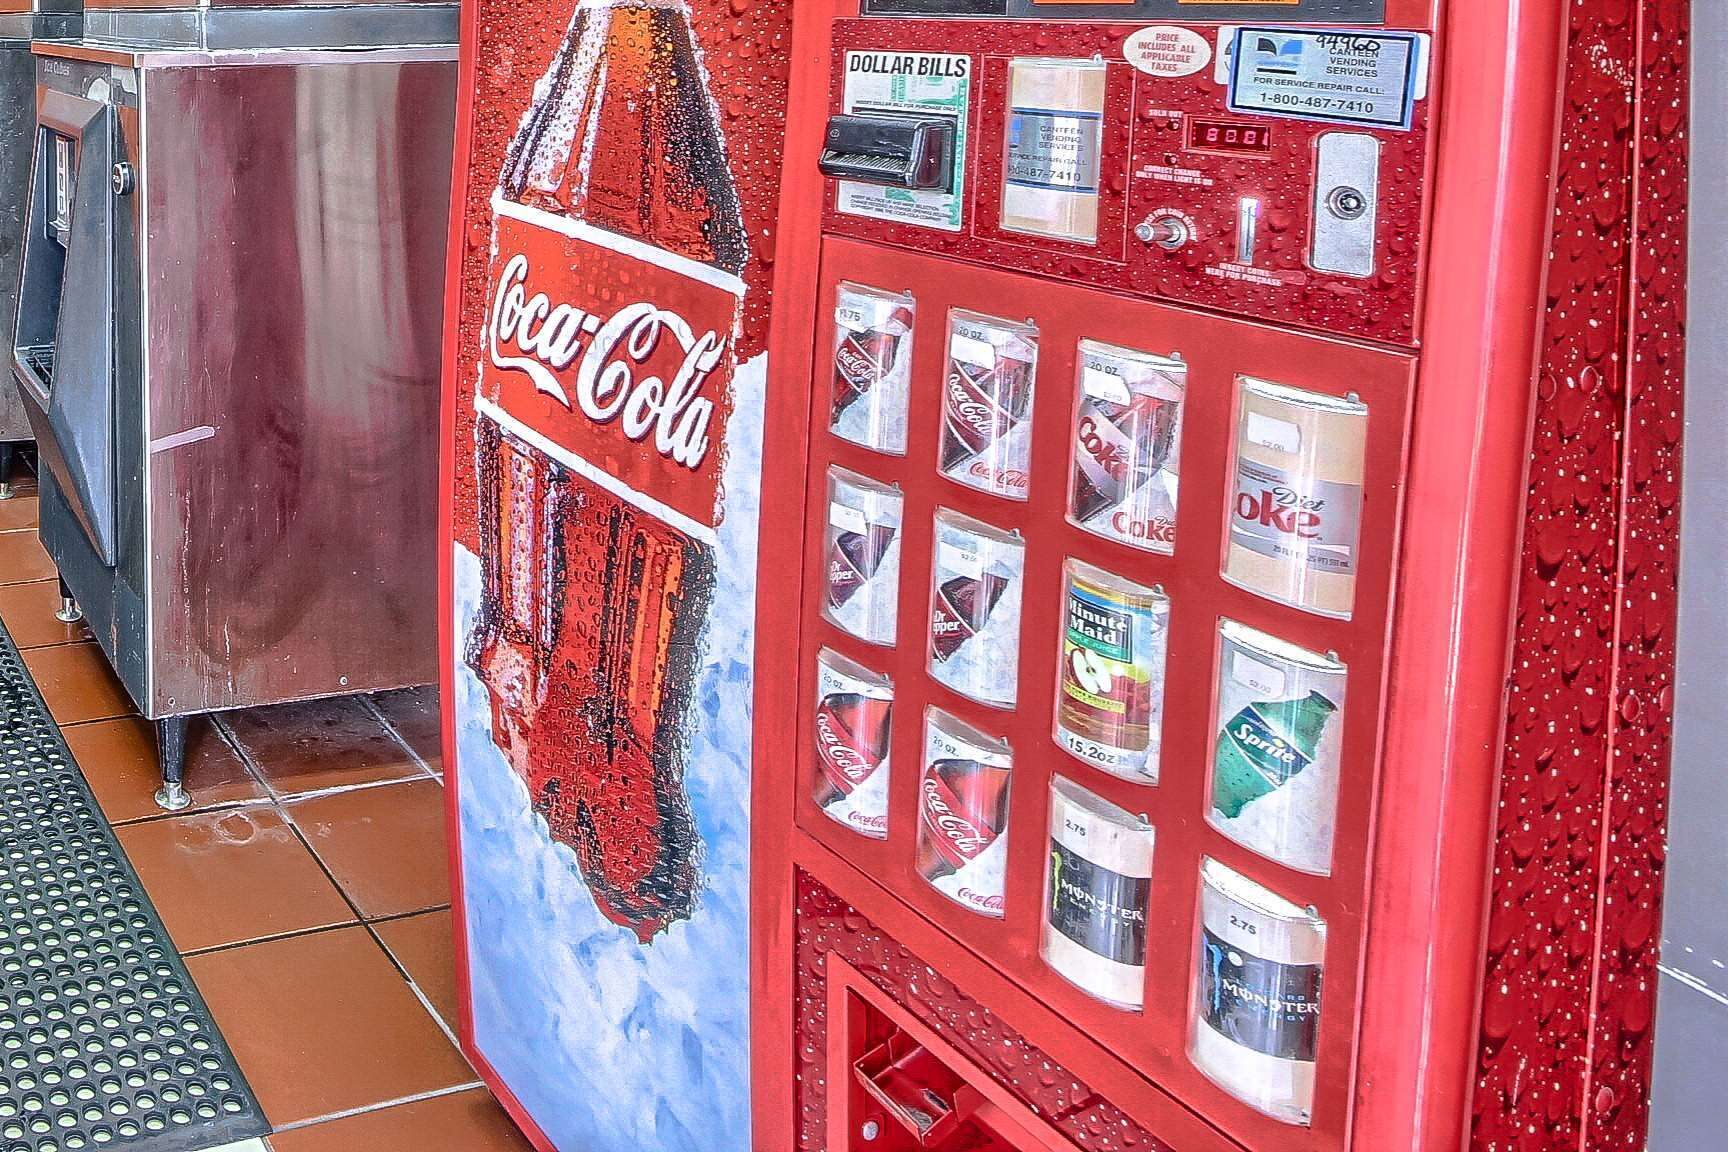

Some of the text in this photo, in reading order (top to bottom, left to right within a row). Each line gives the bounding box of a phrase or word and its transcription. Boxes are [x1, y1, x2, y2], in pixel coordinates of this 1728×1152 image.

[1155, 33, 1180, 43] PRICE
[1138, 42, 1197, 55] INCLUDES ALL
[1140, 52, 1192, 64] APPLICABLE
[1328, 48, 1380, 59] CANTEEN
[850, 54, 967, 78] DOLLAR BILLS
[1150, 62, 1179, 73] TAXES
[1329, 56, 1378, 68] VENDING
[1326, 66, 1379, 78] SERVICES
[1254, 76, 1385, 96] FOR SERVICE REPAIR CALL:
[1260, 92, 1374, 114] 1-800-487-7410
[1148, 108, 1184, 118] SOLD OUT
[1040, 125, 1084, 135] CANTEEN
[1040, 134, 1082, 144] VENDING
[958, 326, 969, 338] 20
[489, 253, 728, 472] Coca-Cola
[838, 348, 876, 380] Coca-Cola
[1090, 361, 1102, 372] 20
[1078, 416, 1130, 482] Coke
[970, 460, 1028, 490] Coca-Cola
[1272, 486, 1326, 512] Diet
[1234, 488, 1322, 539] oke
[1112, 511, 1176, 543] Coke
[832, 560, 842, 572] Dr
[830, 570, 855, 584] pper
[934, 610, 946, 624] Dr
[933, 621, 961, 635] pper
[1071, 616, 1118, 646] Maid
[816, 712, 874, 779] Coca-Cola
[932, 735, 944, 748] 20
[1068, 737, 1116, 764] 15.2oz
[1234, 724, 1296, 764] Sprite
[924, 778, 988, 853] Coca-Cola
[1064, 818, 1086, 837] 2.75
[1060, 878, 1144, 923] MONSTER
[1229, 915, 1257, 936] 2.75
[1222, 978, 1322, 1015] MONSTER
